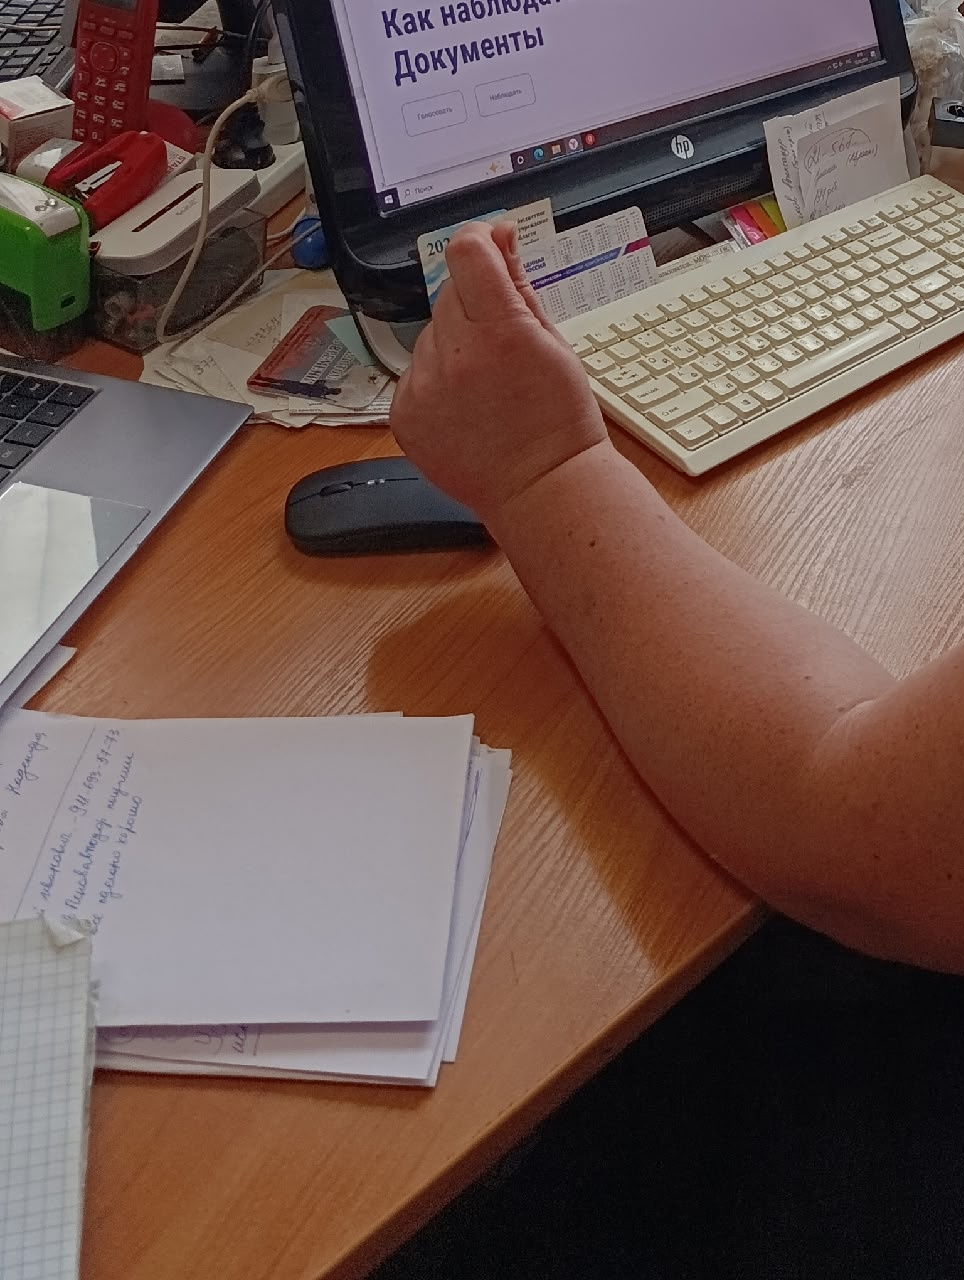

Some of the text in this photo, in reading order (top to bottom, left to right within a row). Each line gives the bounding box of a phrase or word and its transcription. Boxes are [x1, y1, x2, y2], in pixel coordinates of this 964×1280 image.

[381, 6, 435, 39] Как
[393, 26, 545, 87] Документы
[489, 88, 522, 102] Наблюдать
[417, 106, 453, 120] Голосовать
[672, 135, 692, 159] hp
[426, 237, 450, 257] 202
